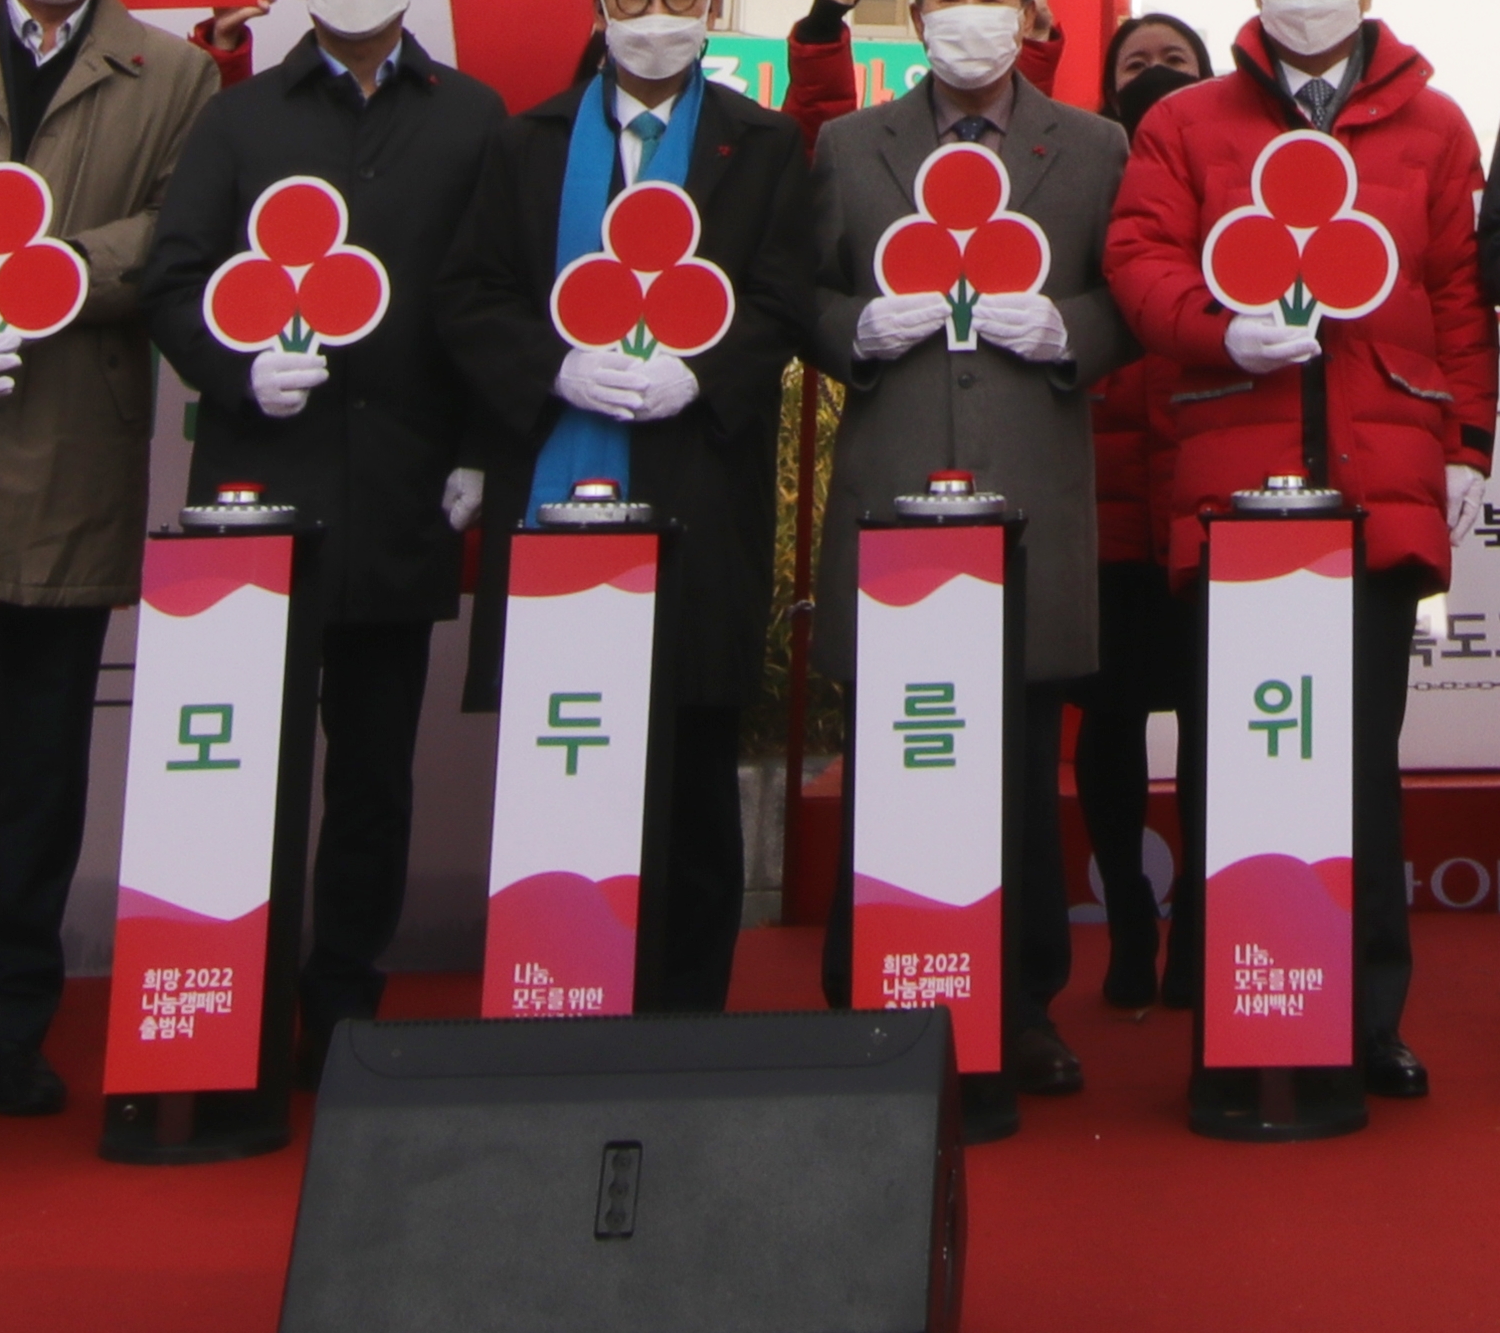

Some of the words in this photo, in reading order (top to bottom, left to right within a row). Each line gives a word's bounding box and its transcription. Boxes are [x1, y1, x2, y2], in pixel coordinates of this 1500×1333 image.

[893, 682, 965, 768] 를
[1248, 675, 1312, 760] 위
[166, 703, 241, 771] 모
[536, 692, 610, 775] 두
[883, 954, 918, 975] 희망
[923, 954, 970, 973] 2022
[143, 968, 180, 990] 희망
[185, 968, 233, 988] 2022
[883, 977, 971, 999] 나눔캠페인
[1234, 968, 1285, 991] 모두를
[1288, 968, 1323, 991] 위한
[142, 991, 233, 1014] 나눔캠페인
[513, 987, 564, 1010] 모두를
[567, 987, 603, 1010] 위한
[1234, 993, 1304, 1016] 사회백신
[139, 1016, 193, 1040] 출범식
